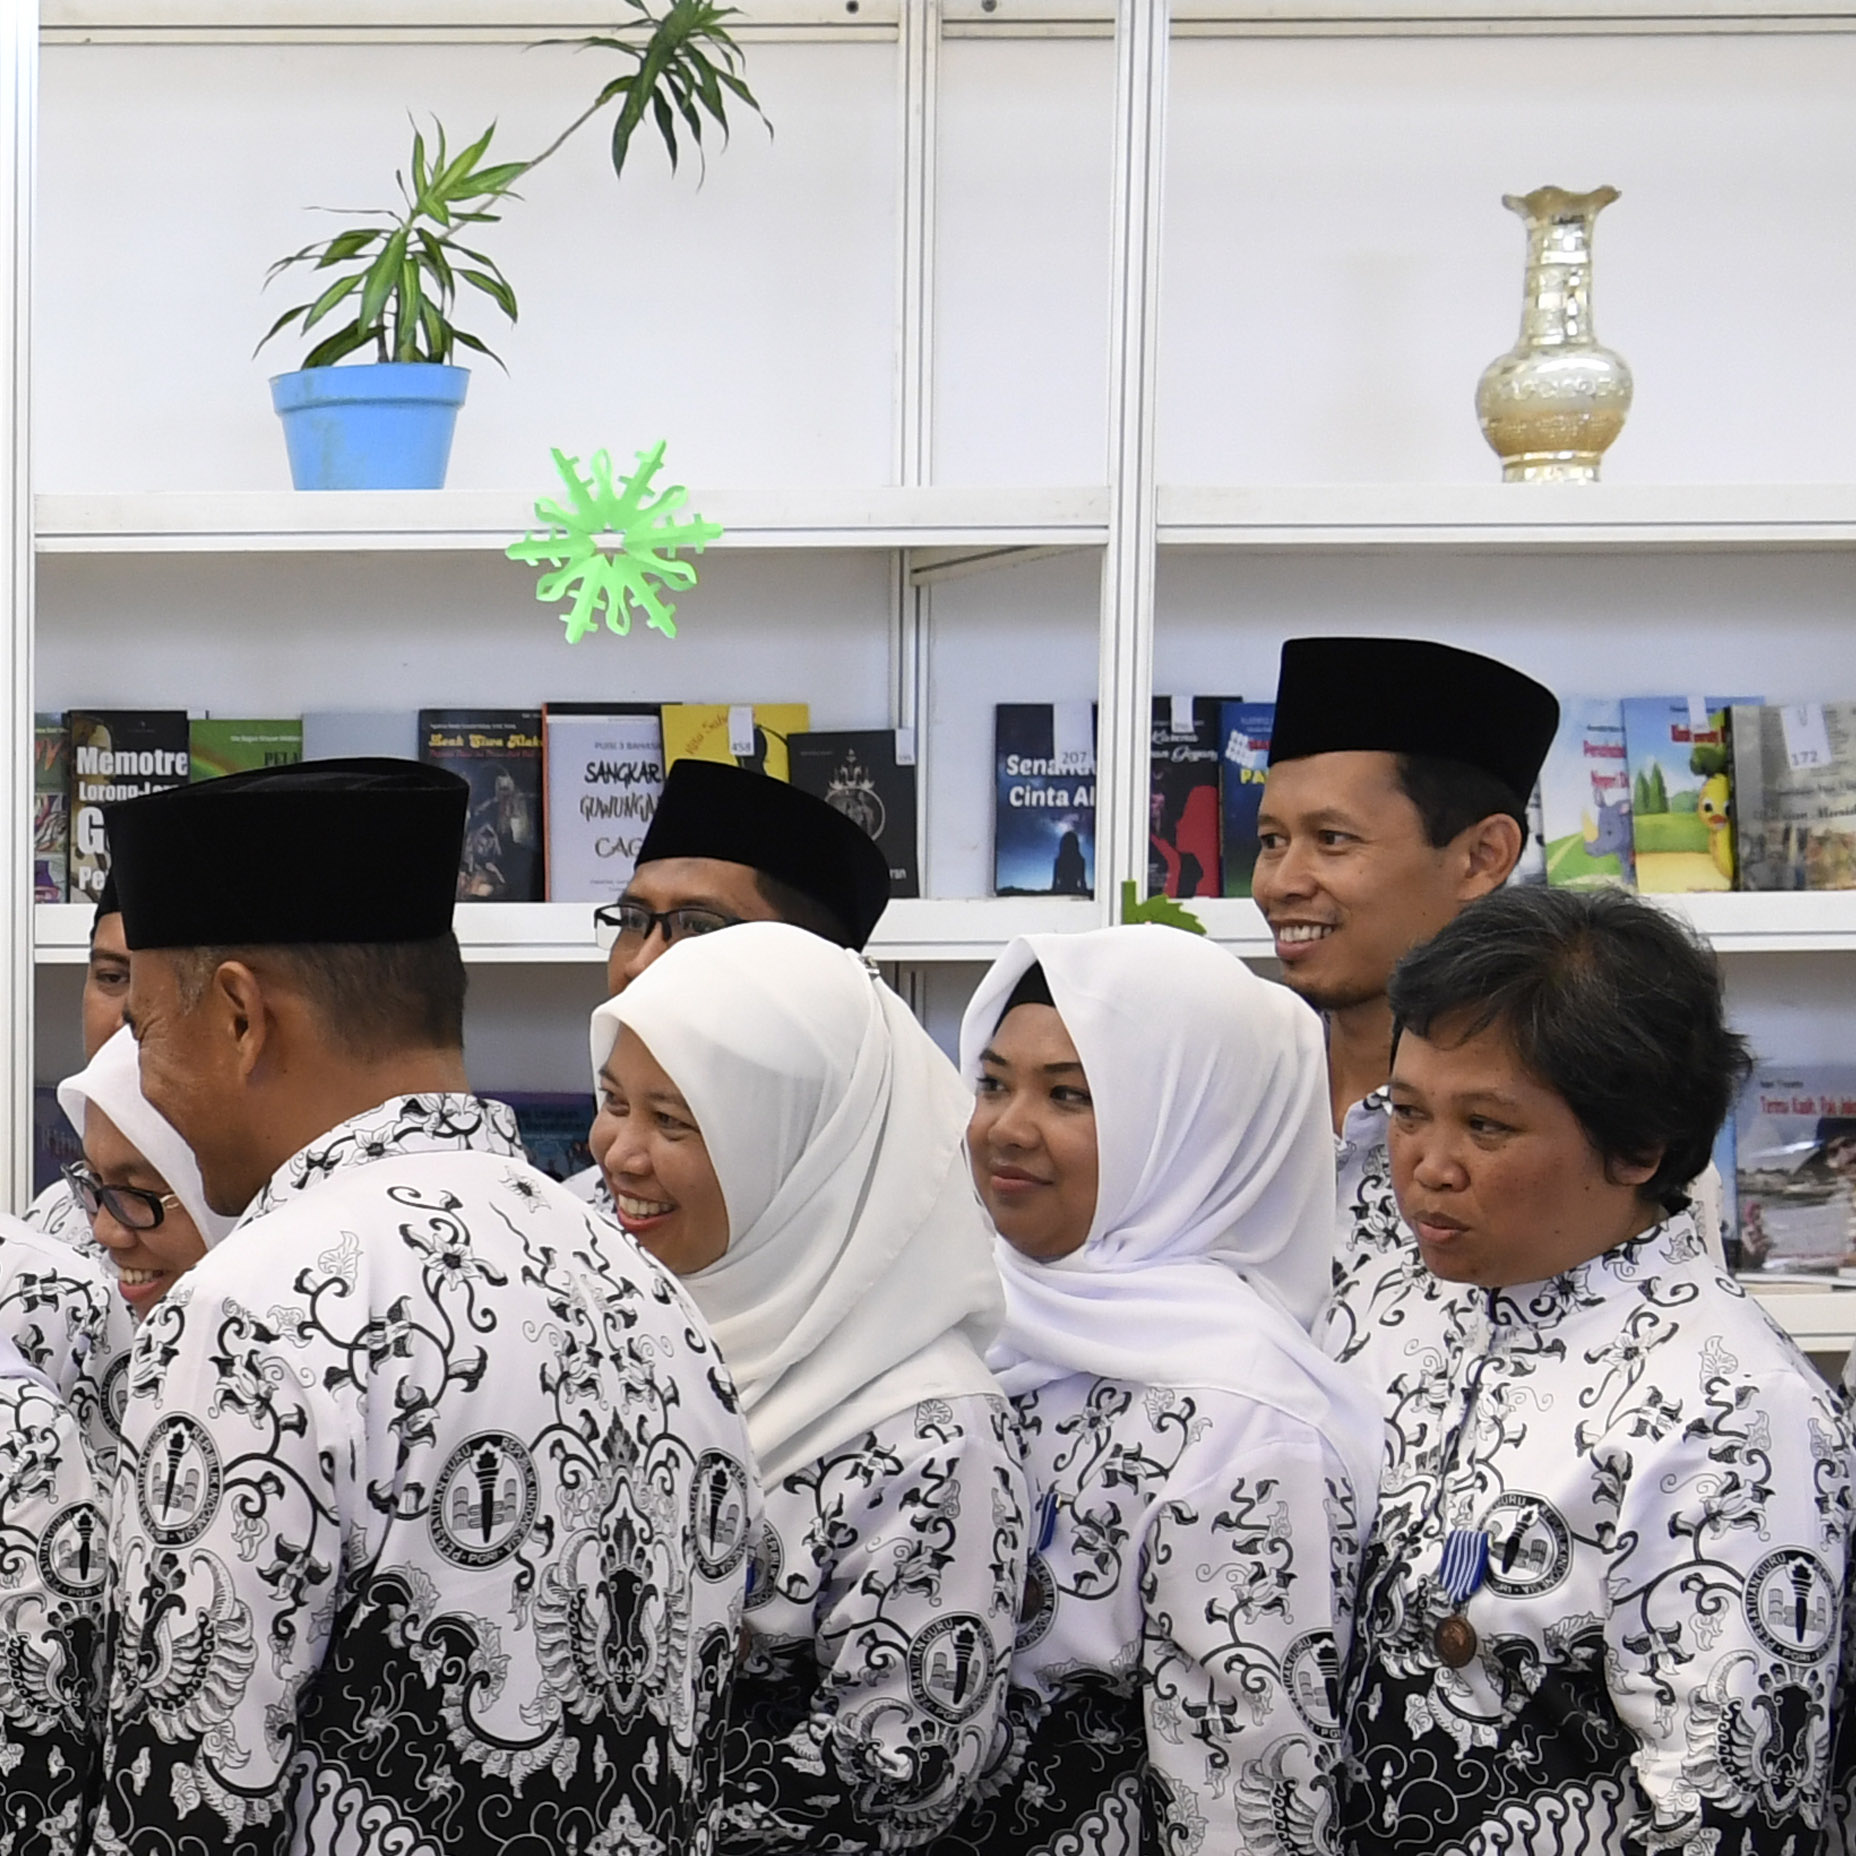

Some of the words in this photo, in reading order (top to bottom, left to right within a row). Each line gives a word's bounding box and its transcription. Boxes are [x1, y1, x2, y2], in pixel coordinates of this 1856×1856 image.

[1061, 752, 1088, 765] 207
[584, 760, 662, 790] SANGKAR
[1009, 785, 1069, 807] Cinta
[442, 1446, 473, 1479] GURU
[1758, 1551, 1787, 1575] GURU
[923, 1619, 955, 1646] GURU
